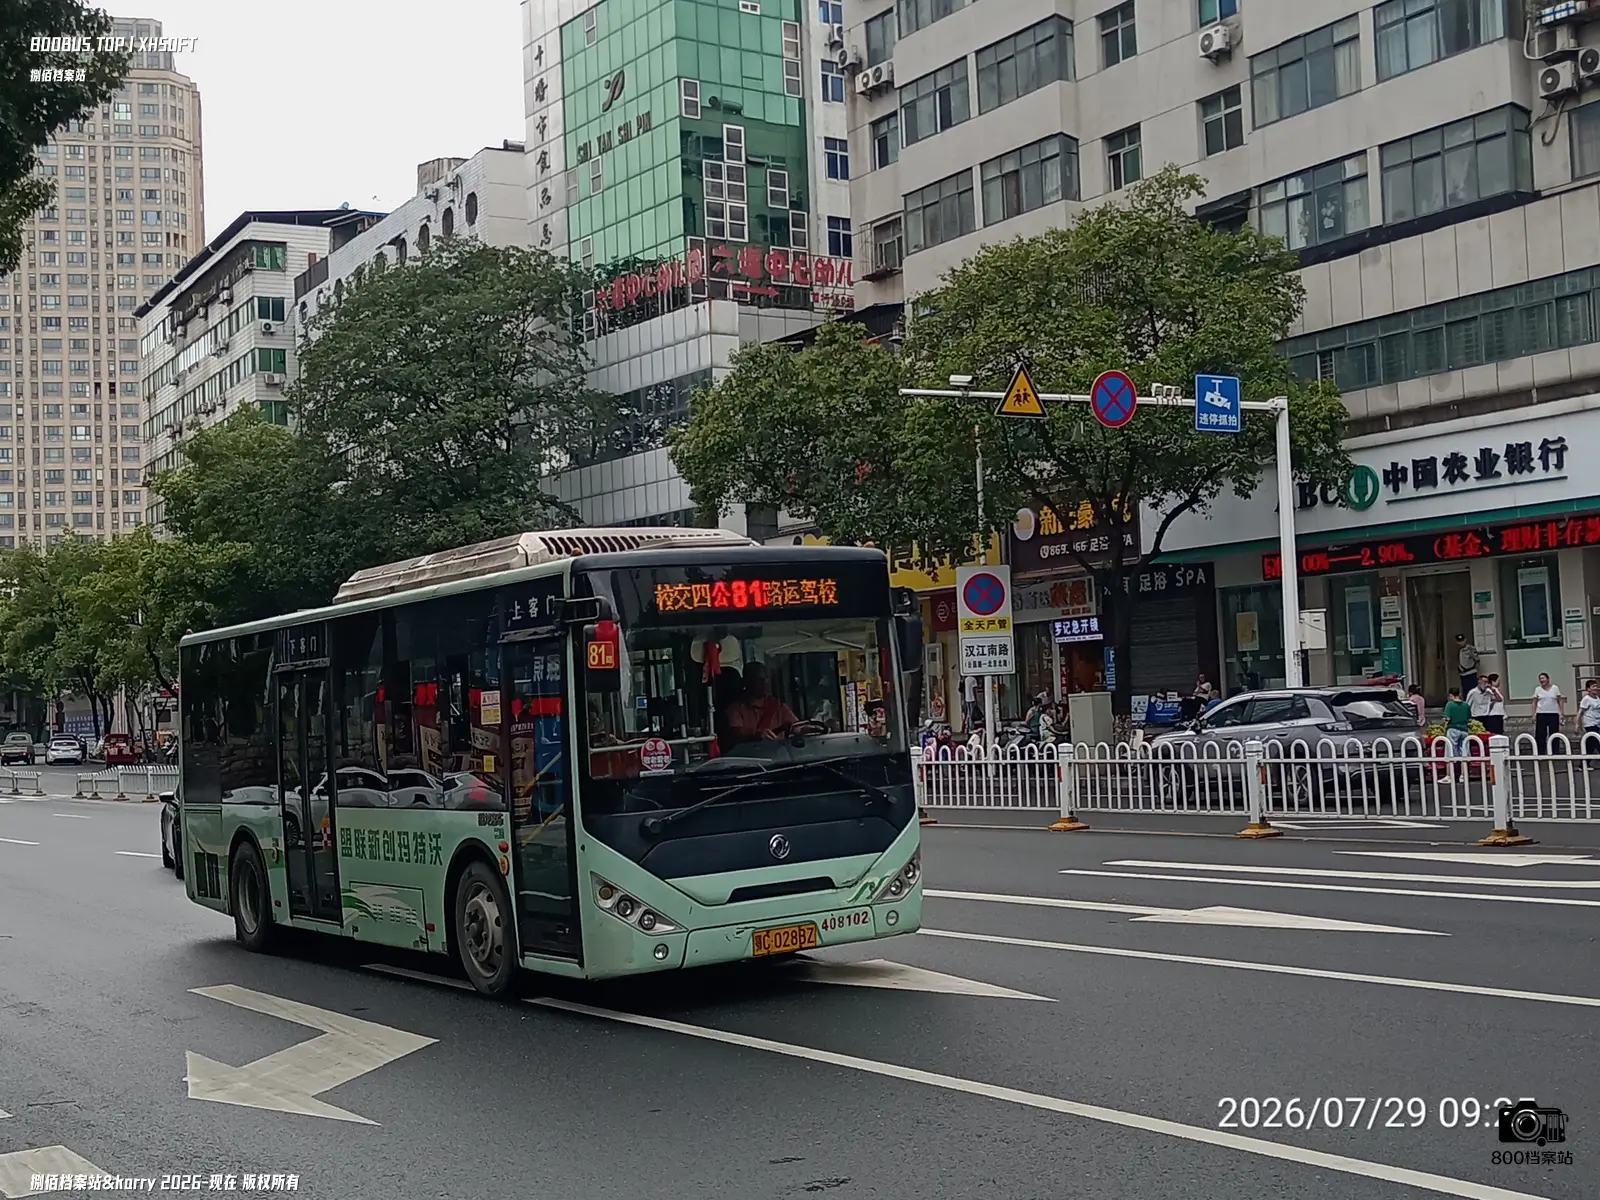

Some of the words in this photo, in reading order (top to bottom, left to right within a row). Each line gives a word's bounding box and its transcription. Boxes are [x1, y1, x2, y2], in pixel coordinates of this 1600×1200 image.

[597, 130, 612, 155] YAN
[1199, 412, 1238, 427] 违停抓拍
[1382, 436, 1568, 493] 中国农业银行
[1275, 481, 1340, 513] BC
[1176, 567, 1208, 586] SPA
[964, 618, 1007, 630] 全天严管
[965, 643, 1009, 658] 汉江南路
[821, 910, 870, 932] 408102
